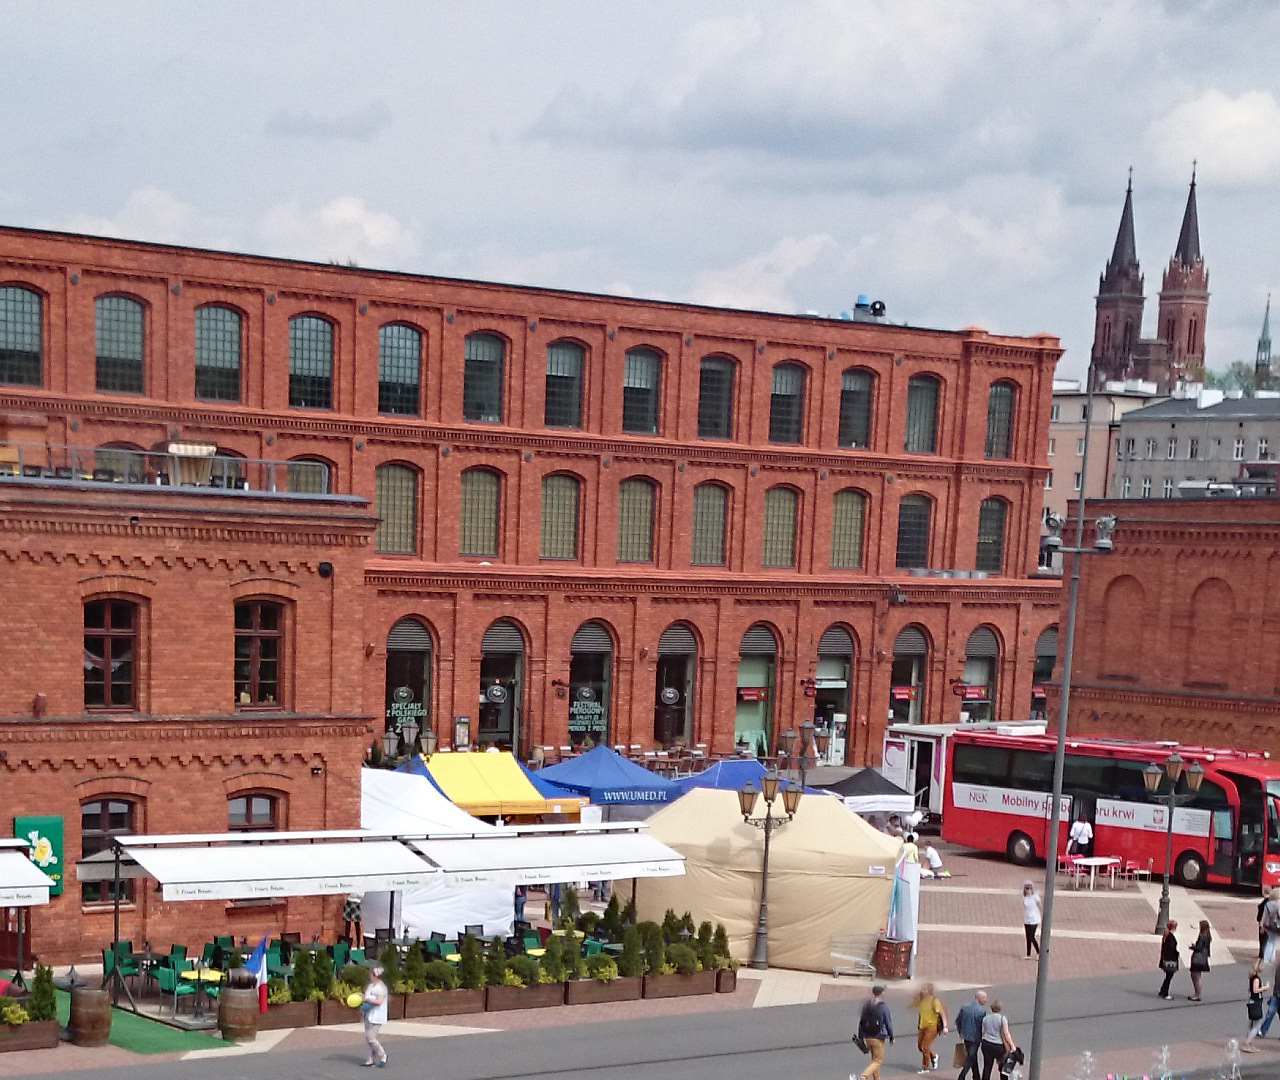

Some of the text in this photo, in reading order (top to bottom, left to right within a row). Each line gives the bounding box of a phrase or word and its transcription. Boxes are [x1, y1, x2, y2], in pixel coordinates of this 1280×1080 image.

[391, 709, 428, 717] POLSKIEGO
[604, 791, 667, 801] WWW.UMED.PL
[1001, 794, 1041, 810] Mobilny
[1112, 806, 1136, 820] krwi
